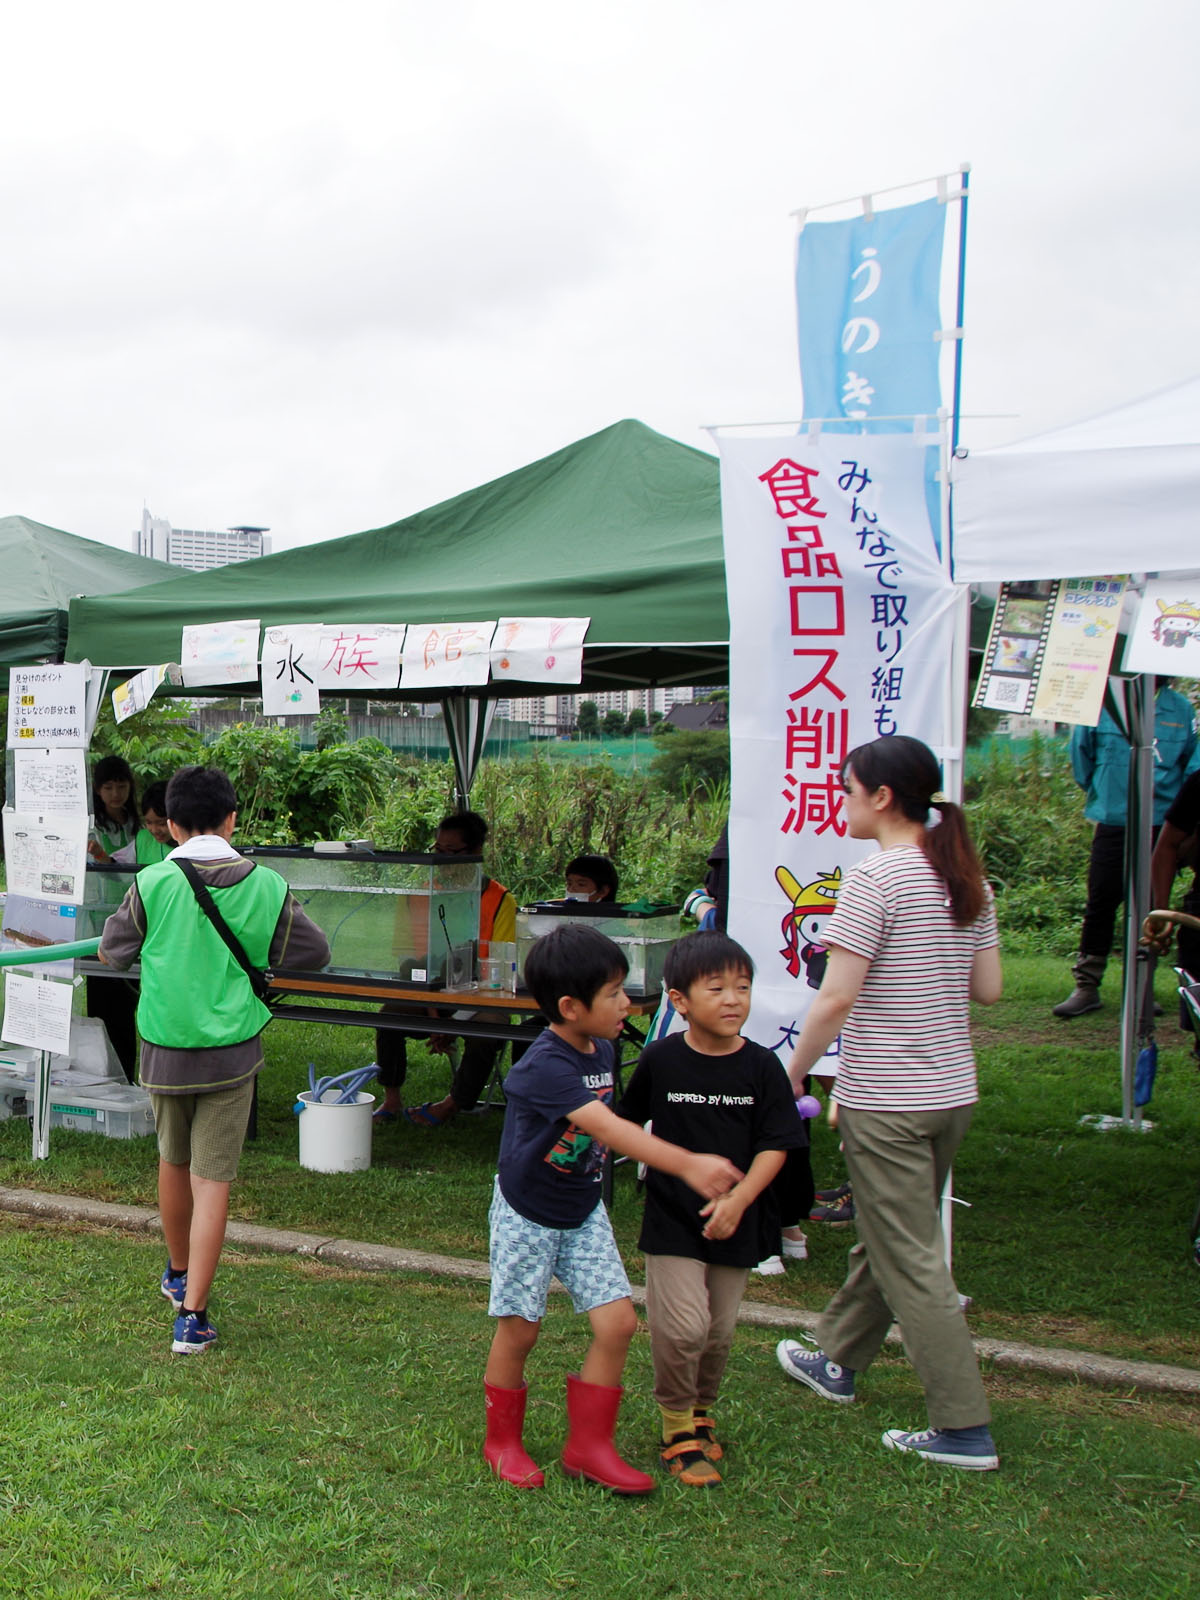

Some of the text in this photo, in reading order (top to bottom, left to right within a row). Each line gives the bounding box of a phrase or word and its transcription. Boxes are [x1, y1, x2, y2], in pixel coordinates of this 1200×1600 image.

[842, 247, 881, 435] うのき
[16, 672, 63, 684] 見分けのポイント
[758, 458, 849, 837] 食品ロス削減
[838, 461, 909, 736] みんなで取り組も
[667, 1092, 755, 1105] INSPIRED BY NATURE
